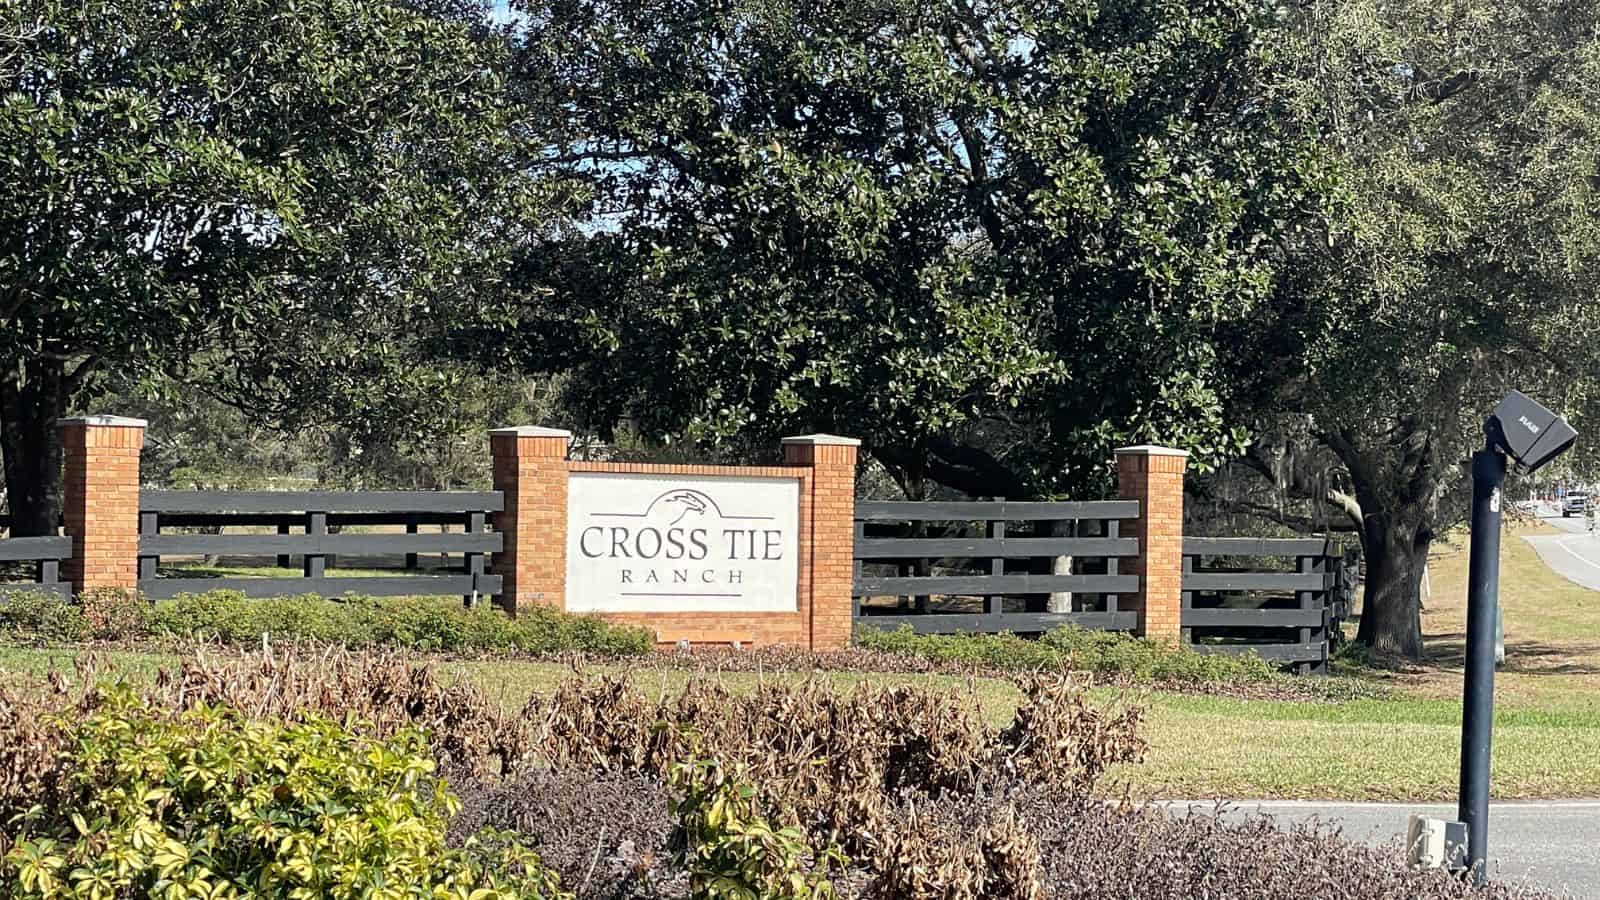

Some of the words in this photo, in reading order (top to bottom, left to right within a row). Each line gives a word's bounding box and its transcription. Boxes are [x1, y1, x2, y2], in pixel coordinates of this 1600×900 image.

[580, 526, 709, 561] CROSS
[722, 529, 784, 561] TIE
[620, 568, 743, 584] RANCH
